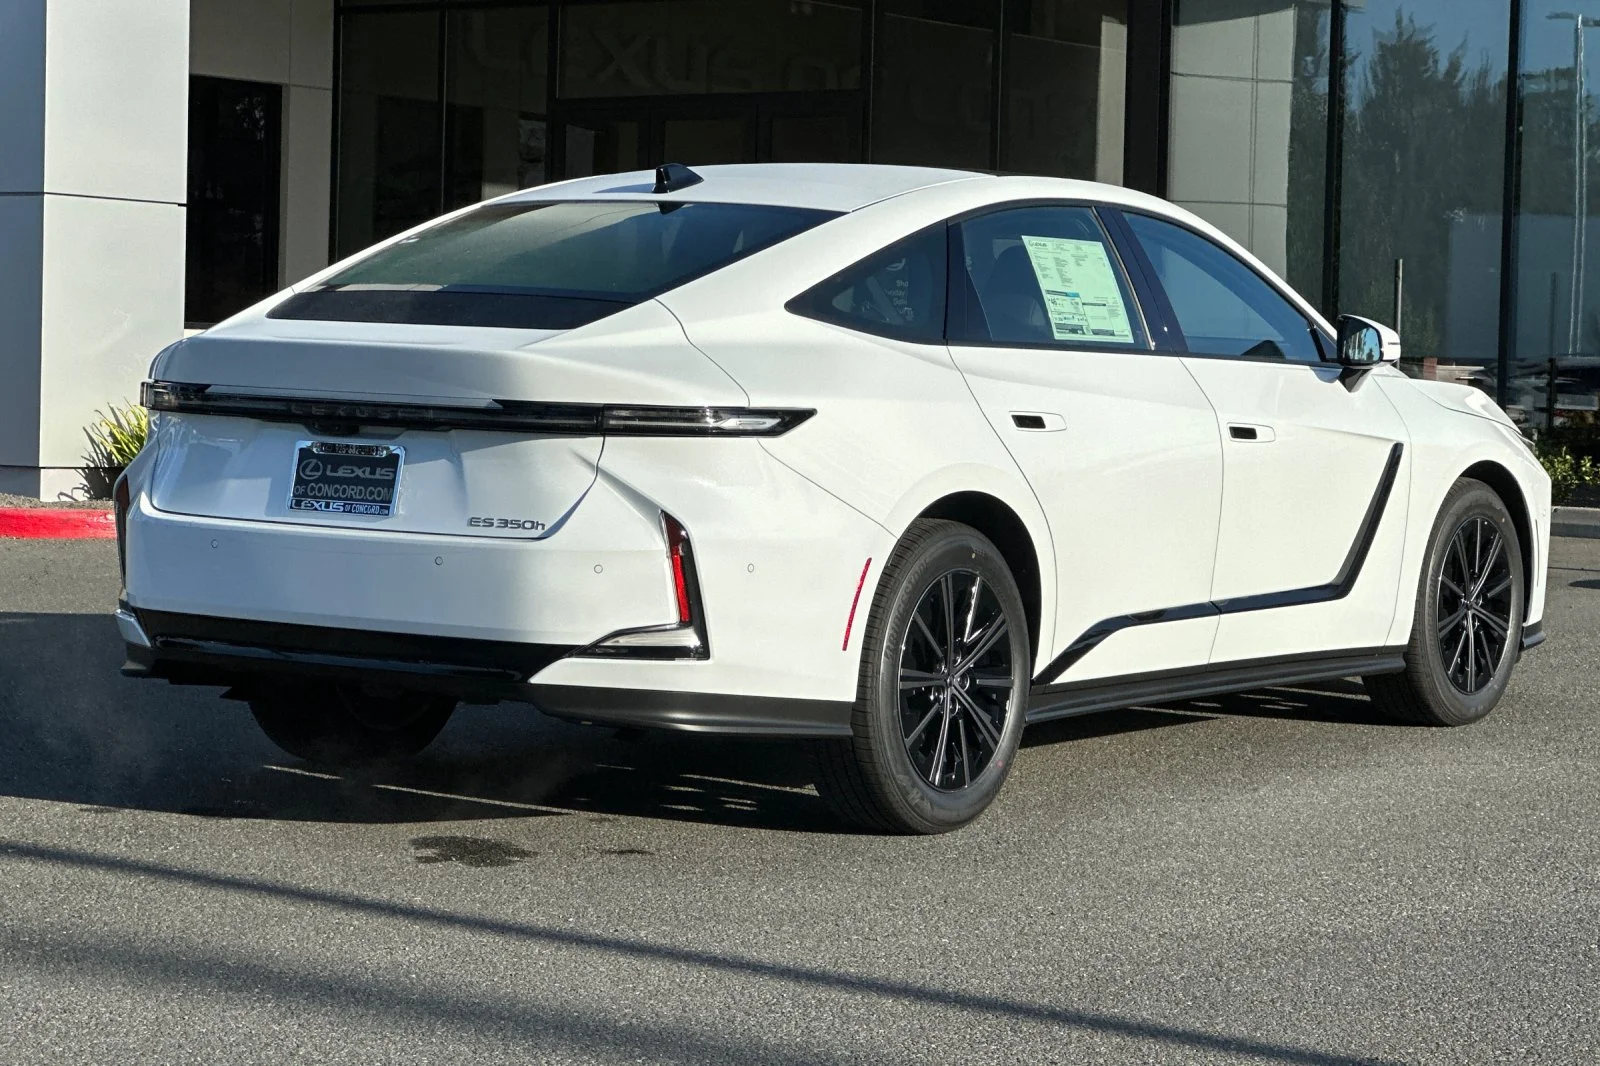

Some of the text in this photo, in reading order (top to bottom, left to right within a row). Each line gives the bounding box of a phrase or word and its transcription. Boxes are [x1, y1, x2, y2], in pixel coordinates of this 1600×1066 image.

[326, 465, 395, 479] LEXUS
[294, 483, 393, 502] OF CONCORD.COM
[291, 500, 344, 512] LEXUS
[345, 504, 351, 512] OF
[469, 516, 546, 531] ES 350h
